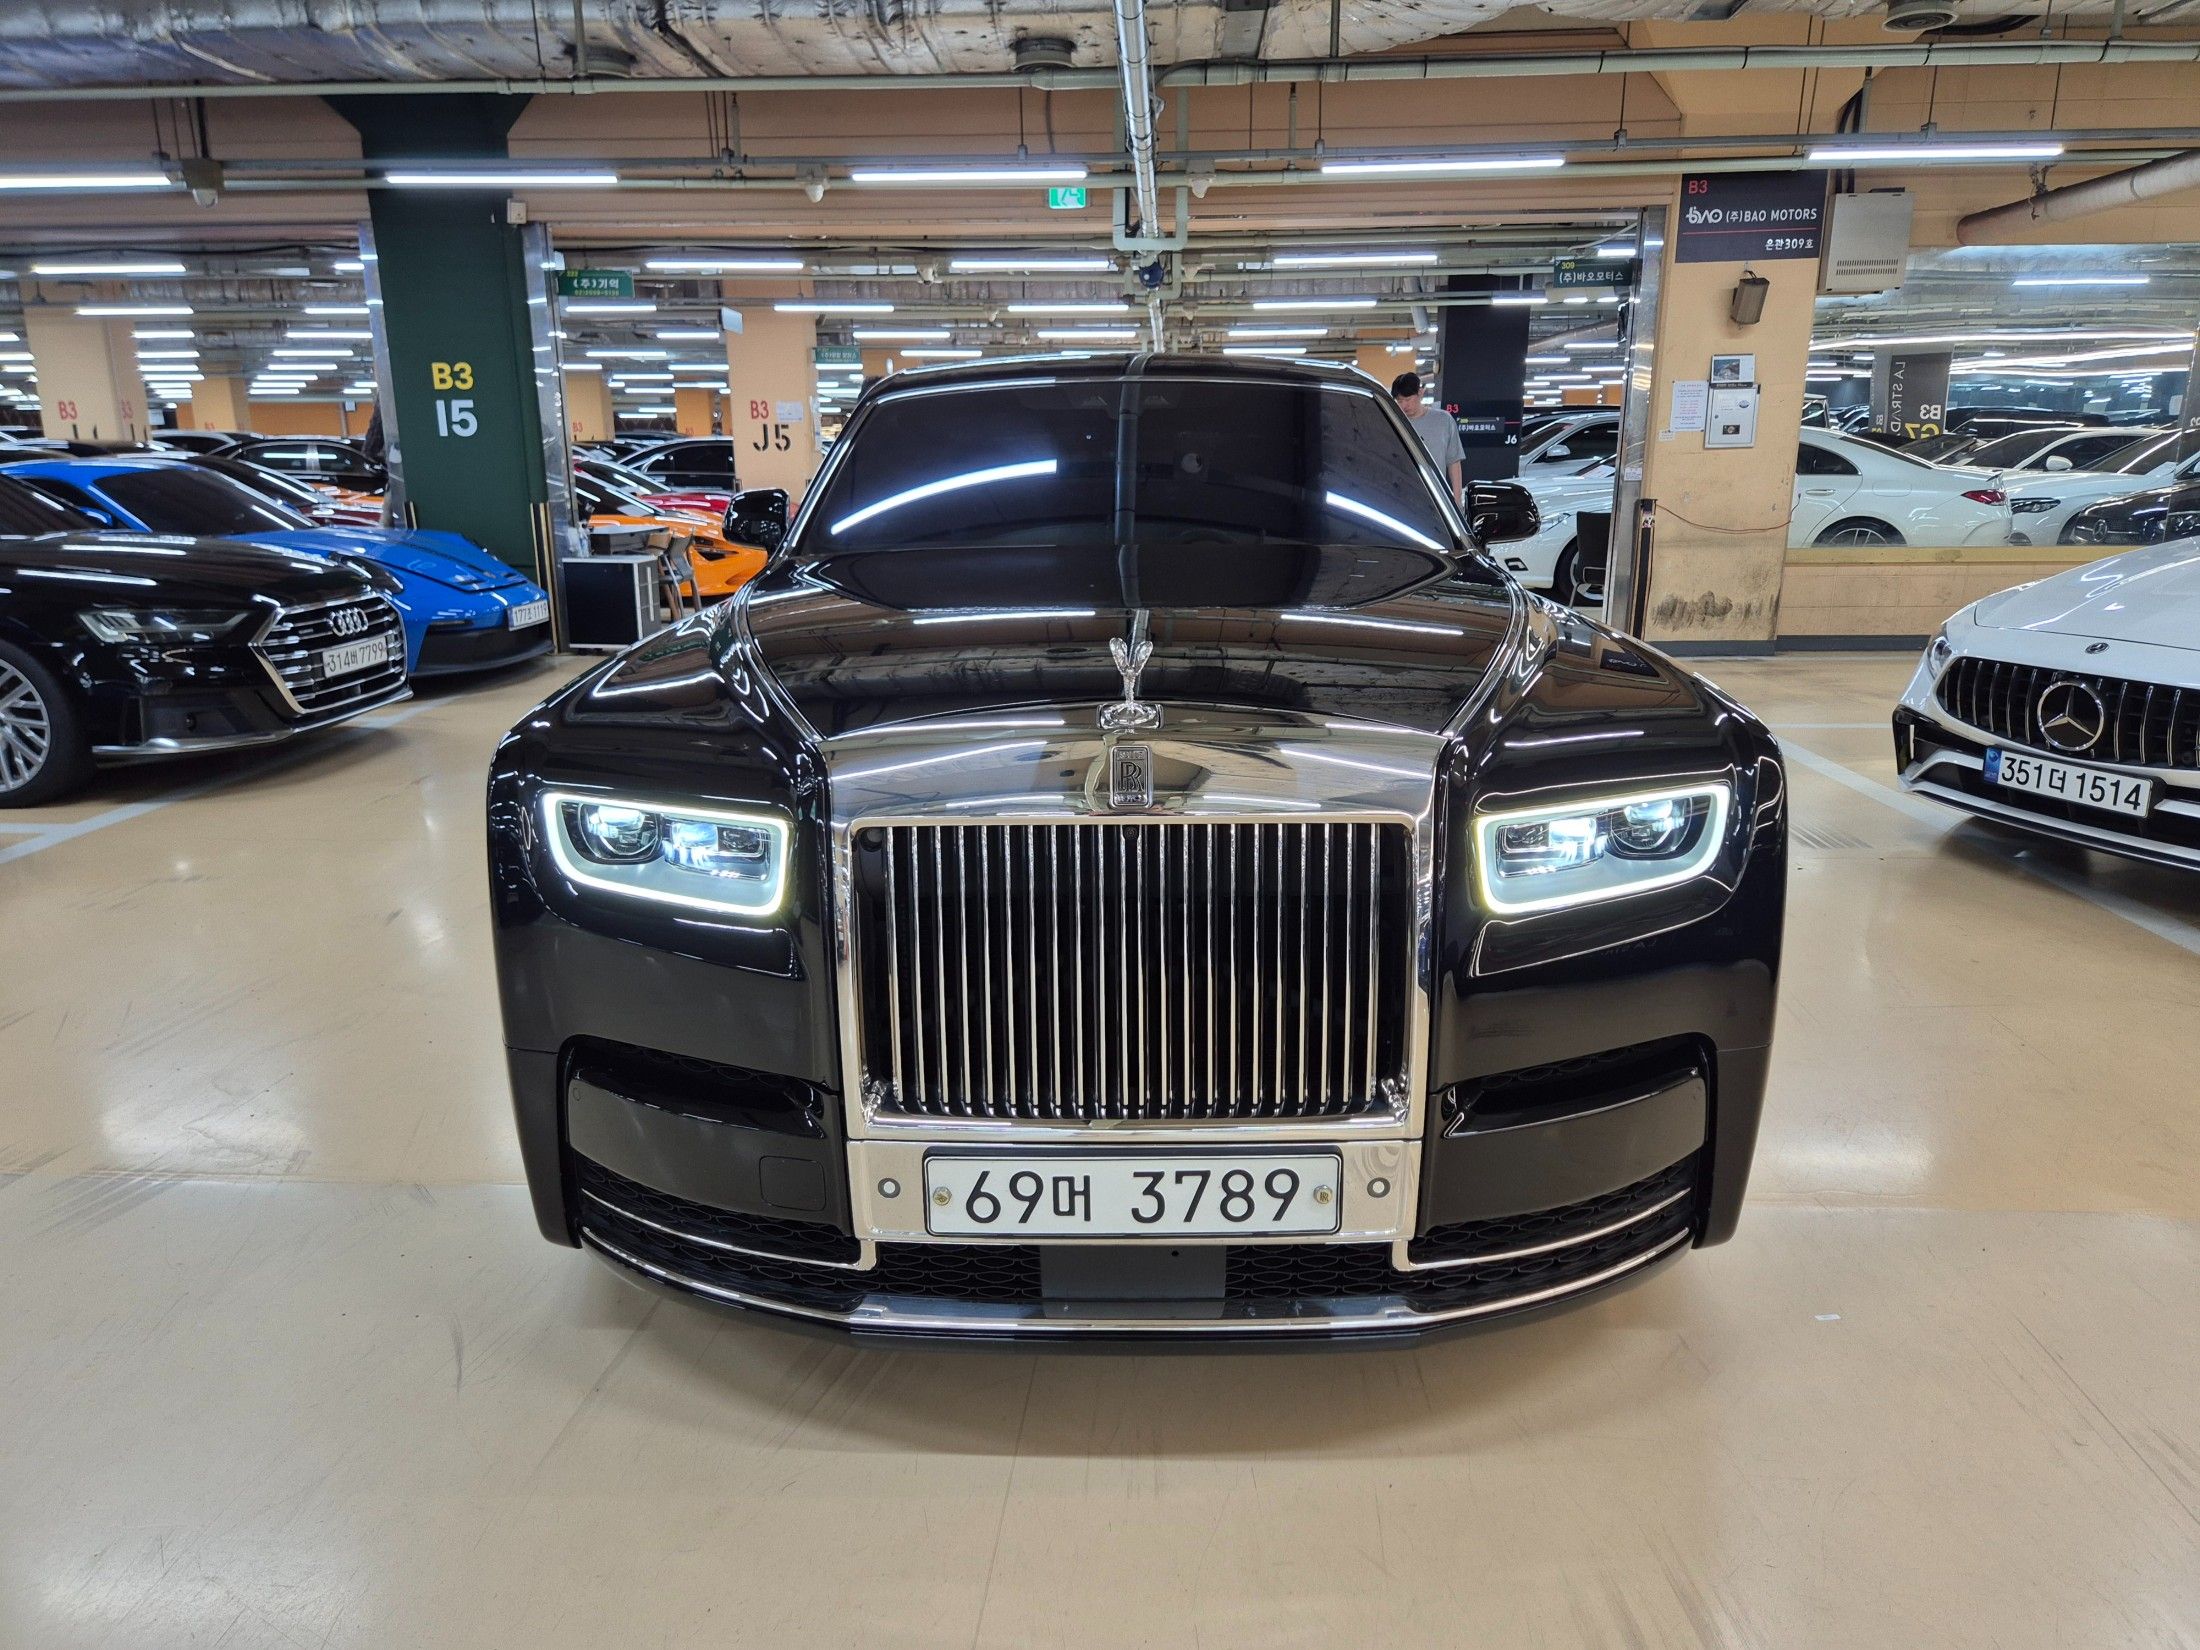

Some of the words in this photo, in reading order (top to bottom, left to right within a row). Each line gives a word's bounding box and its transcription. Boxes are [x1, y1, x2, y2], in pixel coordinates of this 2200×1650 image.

[1688, 180, 1708, 194] B3
[1770, 208, 1817, 221] MOTORS
[1765, 238, 1814, 251] 은관309호
[1561, 262, 1575, 270] 309
[1559, 271, 1624, 283] (주)바오모터스
[431, 362, 474, 390] B3
[58, 401, 78, 420] B3
[750, 400, 769, 419] B3
[1446, 404, 1459, 413] B3
[753, 424, 791, 452] J5
[1504, 434, 1518, 445] J6
[359, 641, 384, 664] 7799
[2001, 757, 2067, 794] 351더
[2076, 773, 2142, 811] 1514
[965, 1170, 1091, 1224] 69머
[1130, 1168, 1301, 1224] 3789
